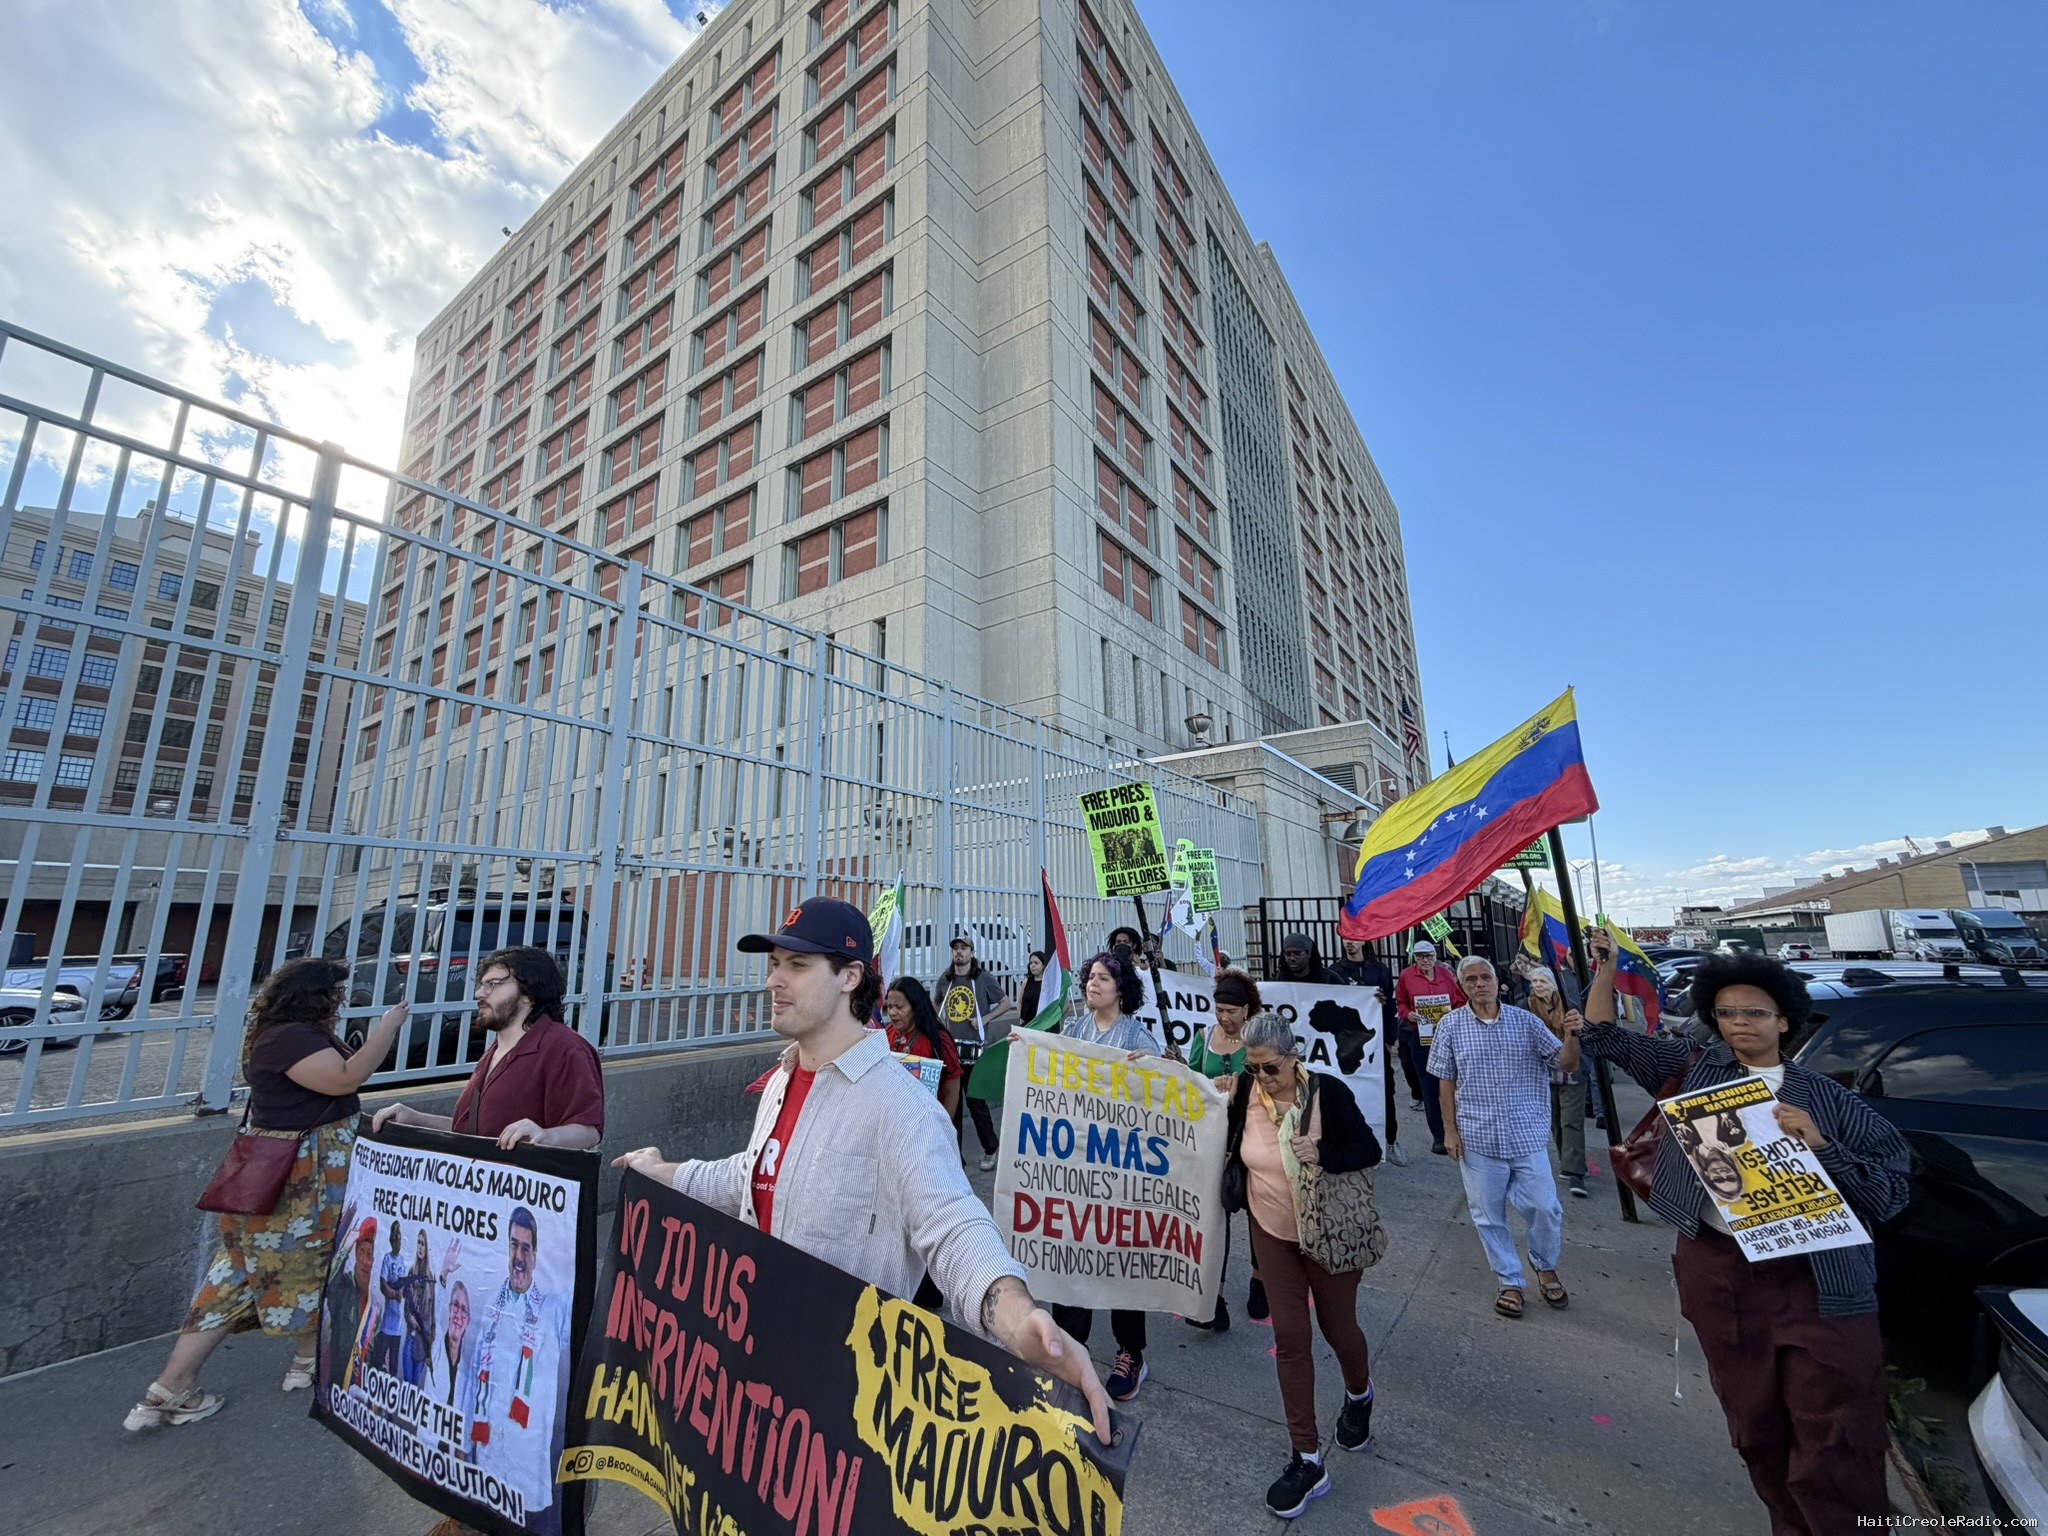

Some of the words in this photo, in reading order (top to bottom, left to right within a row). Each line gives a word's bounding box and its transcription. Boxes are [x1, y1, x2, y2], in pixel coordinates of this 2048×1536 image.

[1081, 790, 1110, 812] FREE
[1110, 783, 1149, 807] PRES.
[1089, 805, 1140, 831] MADURO
[1143, 805, 1154, 821] &
[1101, 861, 1120, 874] FIRST
[1120, 853, 1165, 870] COMBATANT
[1105, 872, 1127, 888] CILIA
[1127, 866, 1167, 886] FLORES
[1116, 884, 1162, 896] WORKERS.ORG
[920, 1066, 940, 1082] FREE
[1027, 1044, 1206, 1122] LIBERTAD
[1680, 1095, 1710, 1109] WAR
[1703, 1090, 1771, 1112] BROOKLYN
[1710, 1081, 1765, 1101] AGAINST
[1026, 1087, 1067, 1115] PARA
[1074, 1093, 1138, 1128] MADURO
[1138, 1107, 1152, 1132] Y
[1155, 1114, 1196, 1151] CILIA
[1018, 1112, 1075, 1160] NO
[1086, 1123, 1170, 1176] MÁS
[1735, 1137, 1808, 1170] FLORES!
[355, 1143, 369, 1169] FREE
[368, 1149, 424, 1181] PRESIDENT
[423, 1159, 485, 1194] NICOLÁS
[487, 1169, 566, 1213] MADURO
[1758, 1158, 1807, 1183] CILIA
[1123, 1176, 1201, 1221] ILEGALES
[1741, 1172, 1829, 1211] RELEASE
[1800, 1195, 1840, 1212] SUPPORT
[373, 1187, 399, 1216] FREE
[400, 1194, 432, 1225] CILIA
[436, 1200, 498, 1241] FLORES
[1790, 1217, 1813, 1230] FOR
[1815, 1208, 1850, 1224] PLACE
[1013, 1192, 1203, 1266] DEVUELVAN
[1739, 1223, 1789, 1245] SURGERY!
[1775, 1235, 1796, 1249] NOT
[1796, 1233, 1809, 1244] IS
[1808, 1221, 1852, 1239] PRISON
[1752, 1241, 1775, 1254] THE
[1011, 1235, 1039, 1268] LOS
[1042, 1242, 1094, 1276] FONDOS
[1097, 1250, 1115, 1277] DE
[1118, 1251, 1203, 1295] VENEZUELA
[655, 1216, 696, 1301] TO
[703, 1243, 756, 1354] U.S.
[894, 1309, 981, 1423] FREE
[362, 1366, 399, 1411] LONG
[400, 1384, 430, 1429] LIVE
[433, 1404, 463, 1446] THE
[585, 1363, 662, 1450] HAN
[402, 1433, 524, 1524] REVOLUTION!
